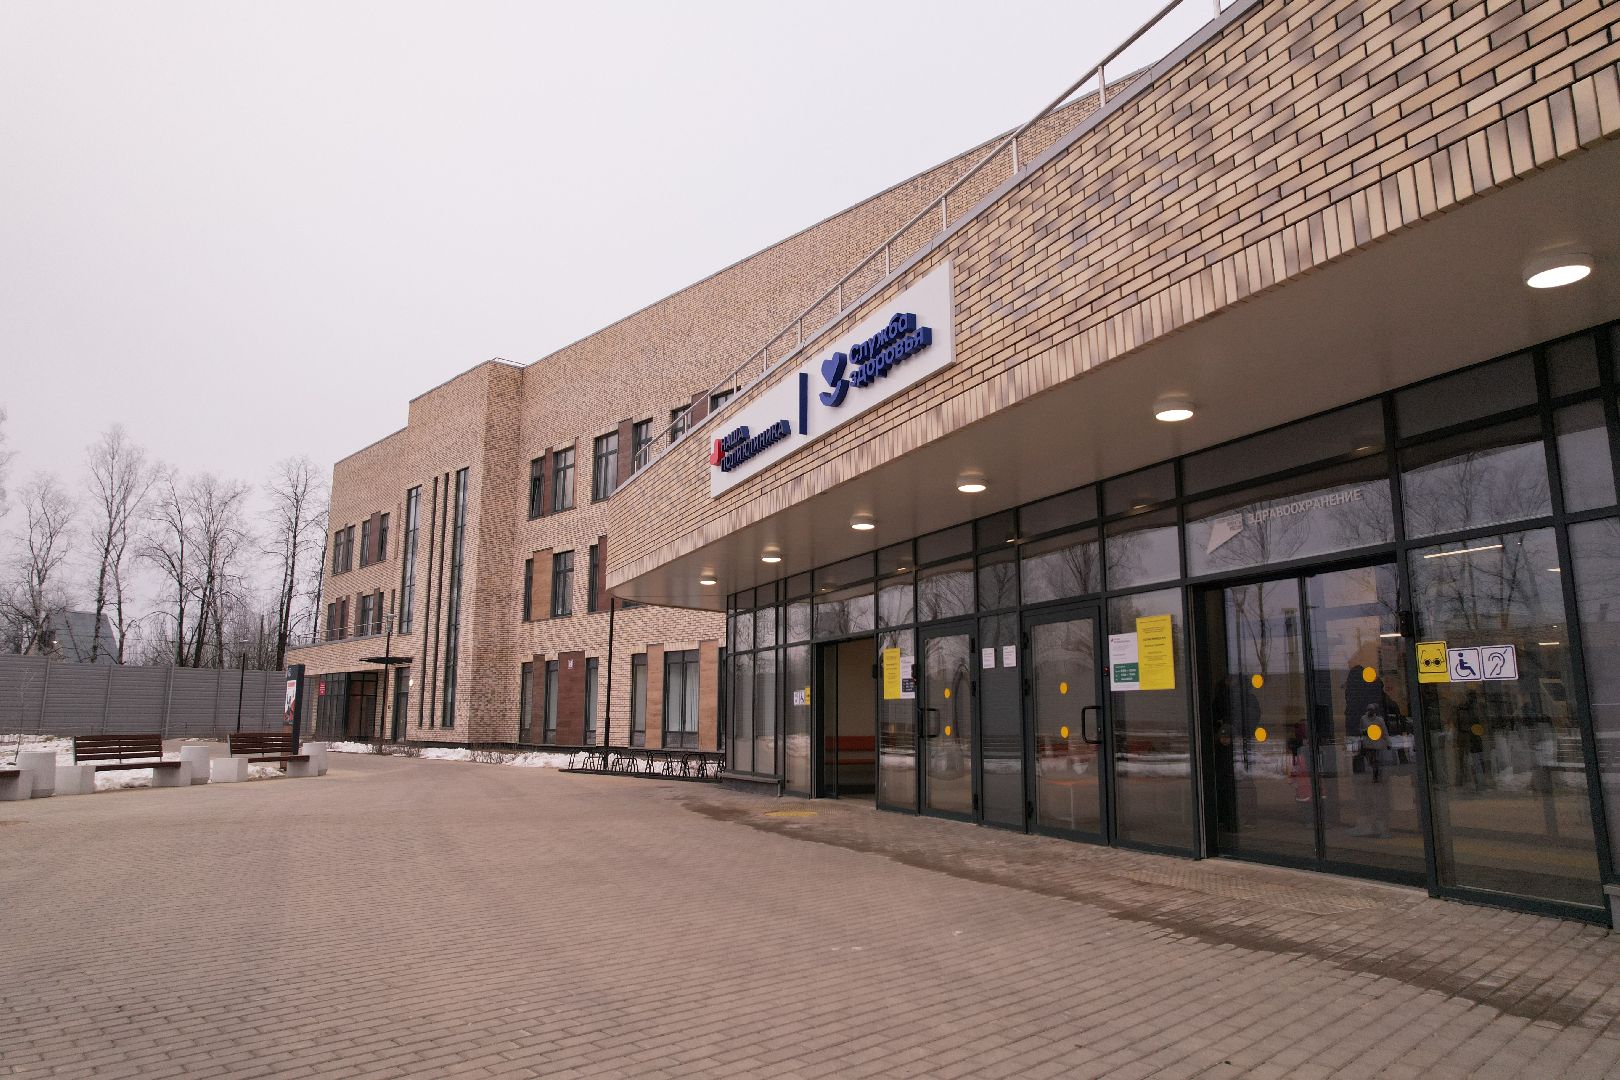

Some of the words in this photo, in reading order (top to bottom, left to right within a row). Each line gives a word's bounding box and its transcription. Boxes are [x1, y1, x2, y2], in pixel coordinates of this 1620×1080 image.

[849, 313, 915, 364] Служба
[849, 327, 931, 387] здоровья
[721, 426, 750, 452] НАША
[721, 420, 791, 472] ПОЛИКЛИНИКА
[1249, 488, 1363, 524] ЗДРАВООХРАНЕНИЕ
